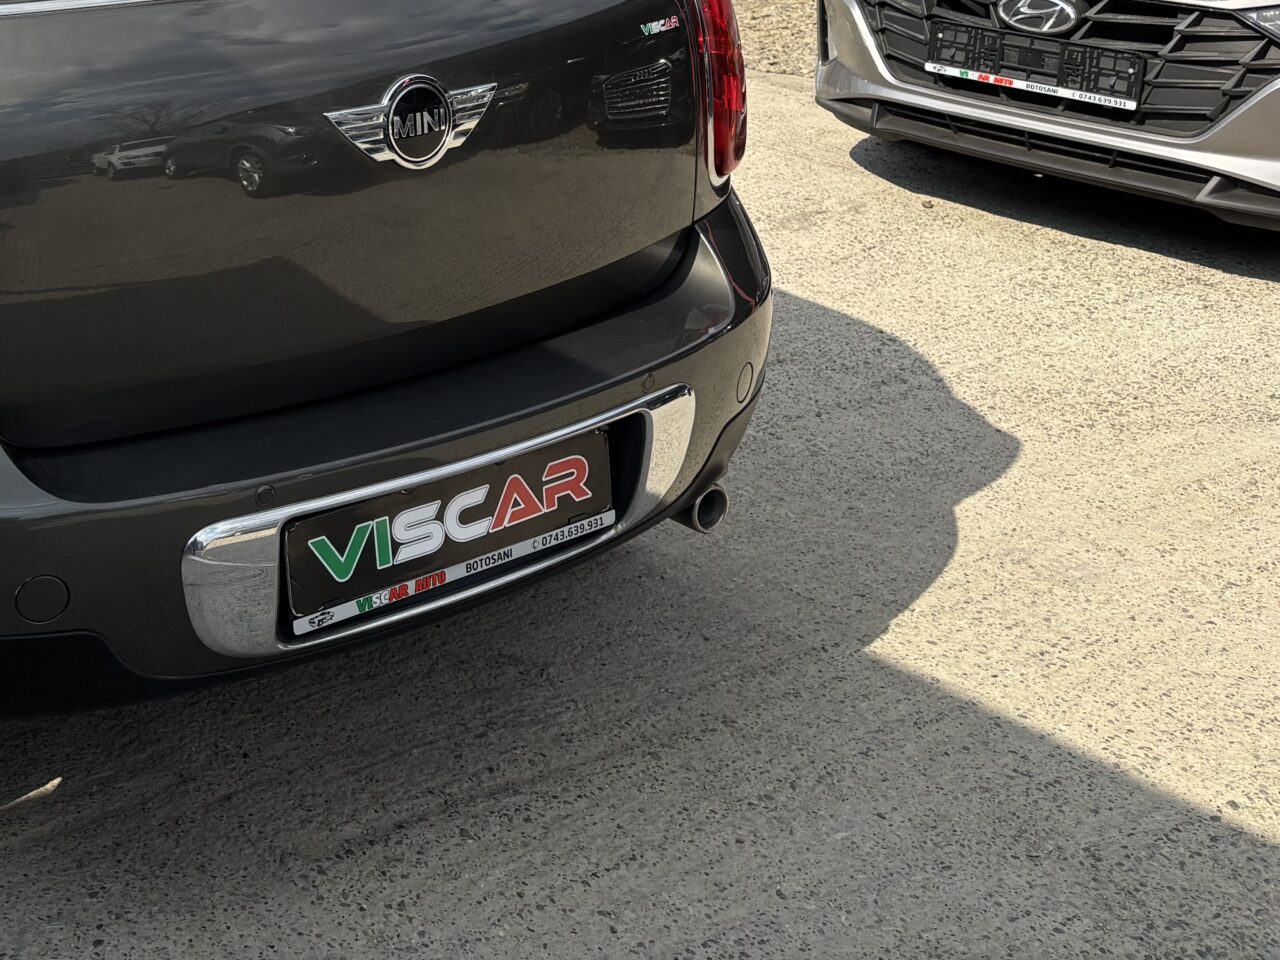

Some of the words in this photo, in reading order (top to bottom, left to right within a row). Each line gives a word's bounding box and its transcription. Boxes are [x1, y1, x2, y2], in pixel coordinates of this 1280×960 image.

[640, 15, 679, 36] VISCAR
[1025, 83, 1059, 94] BOTOSANI
[1078, 93, 1127, 108] 0743.639.931
[393, 108, 446, 139] MINI
[308, 454, 592, 582] VISCAR
[356, 583, 409, 613] VISCAR
[414, 570, 447, 594] AUTO
[465, 547, 514, 574] BOTOSANI
[540, 516, 605, 548] 0743.639.931
